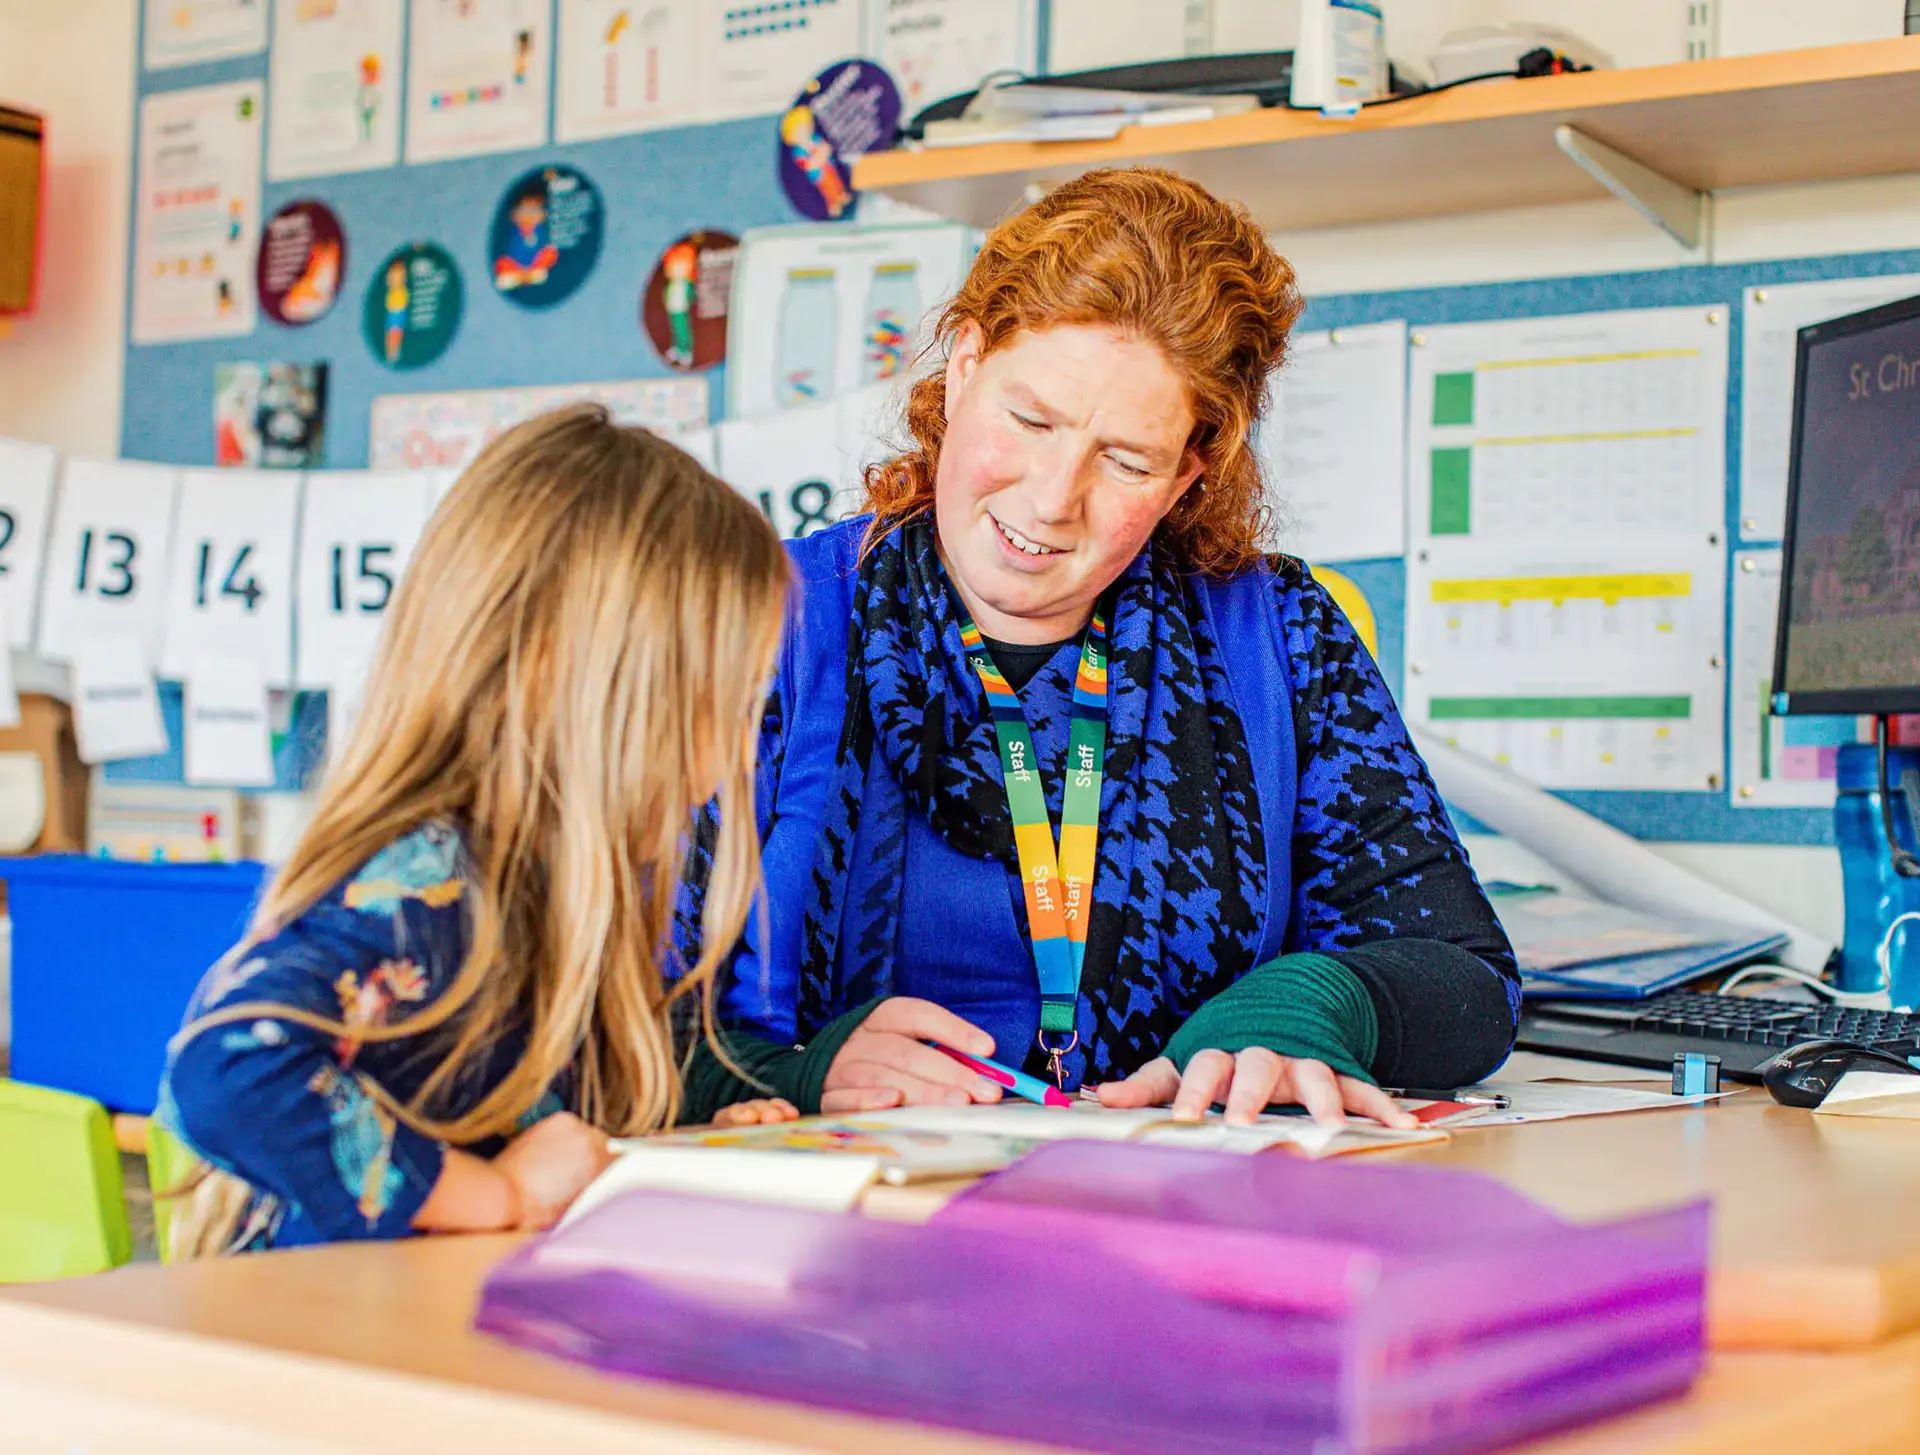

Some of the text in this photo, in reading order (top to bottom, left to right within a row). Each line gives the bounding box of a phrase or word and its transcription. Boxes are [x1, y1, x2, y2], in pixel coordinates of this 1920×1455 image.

[77, 528, 136, 597] 13
[196, 543, 262, 610] 14
[332, 545, 395, 612] 15
[1084, 642, 1099, 681] Staff
[1009, 740, 1032, 783] Staff
[1075, 743, 1095, 789] Staff
[1032, 864, 1055, 912] Staff
[1063, 872, 1083, 921] Staff
